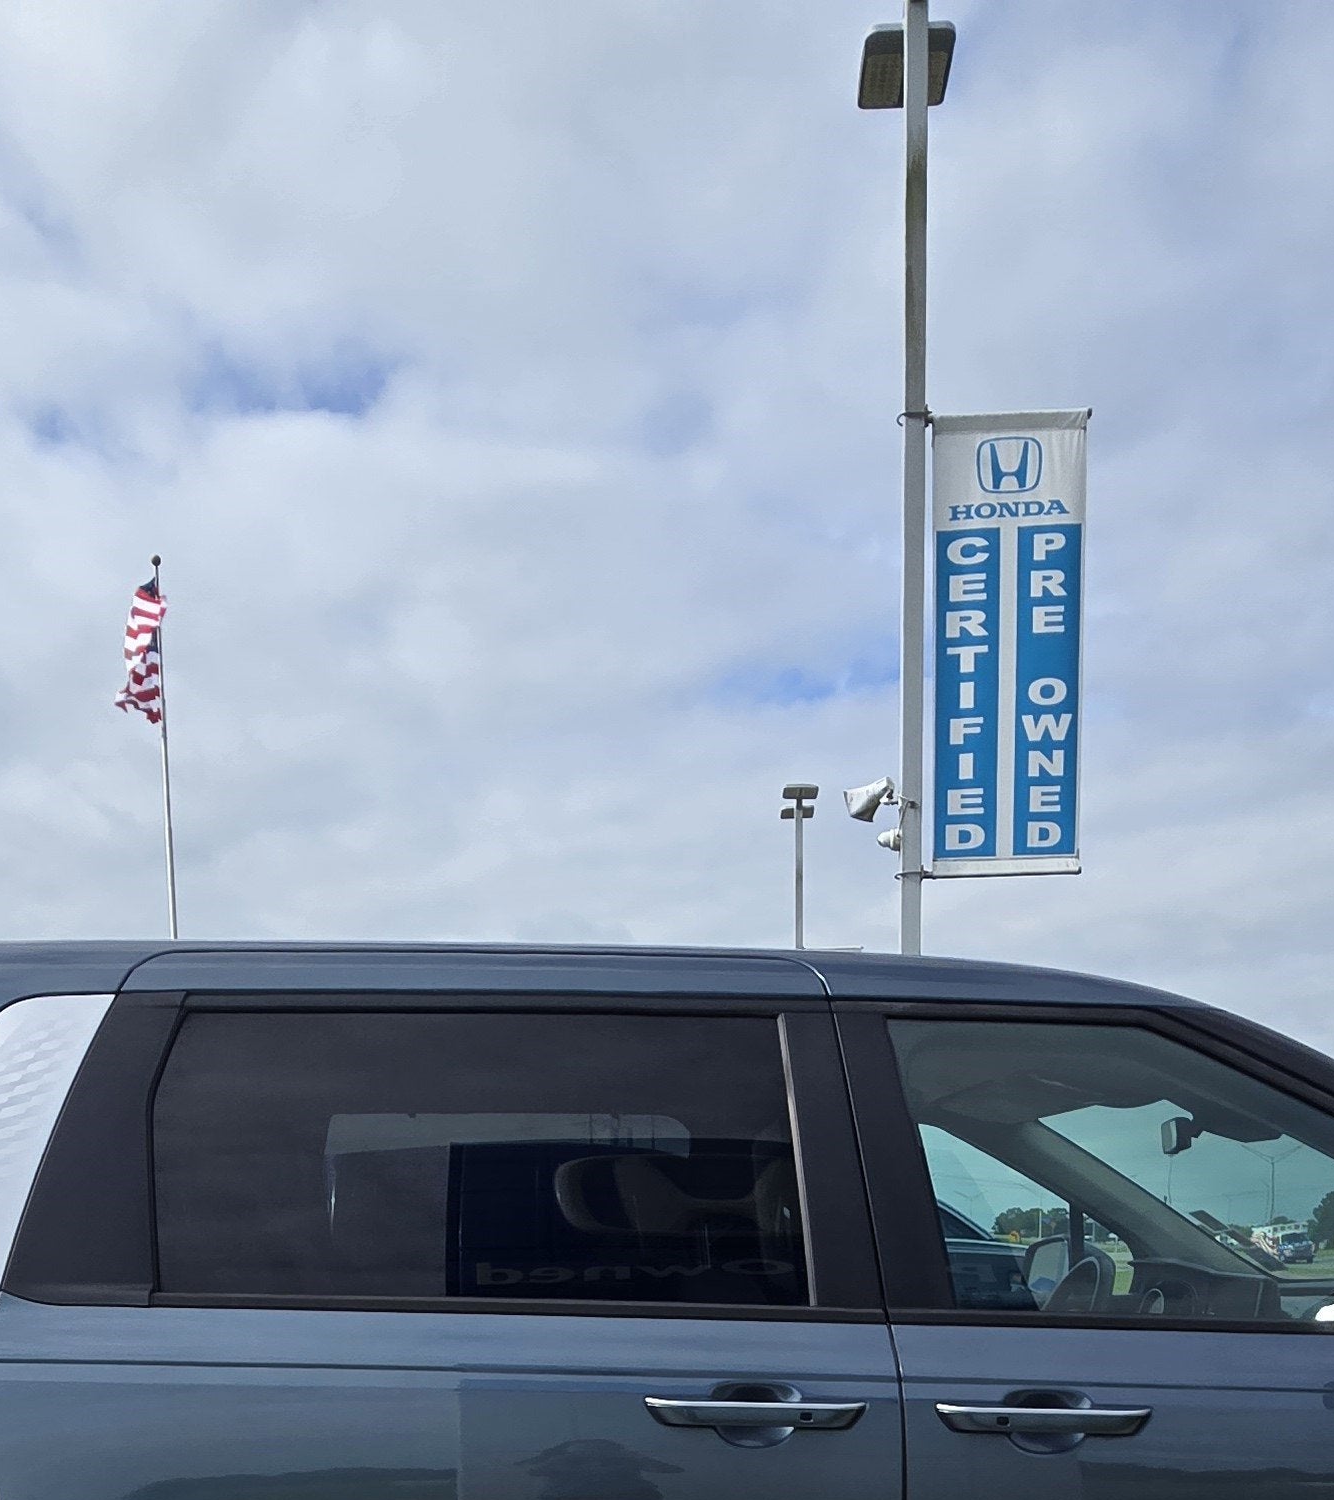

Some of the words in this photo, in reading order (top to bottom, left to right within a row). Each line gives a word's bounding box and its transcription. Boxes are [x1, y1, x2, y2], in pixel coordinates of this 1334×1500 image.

[948, 498, 1070, 522] HONDA
[1030, 532, 1068, 634] PRE
[944, 536, 990, 852] CERTIFIED
[1021, 676, 1073, 849] OWNED
